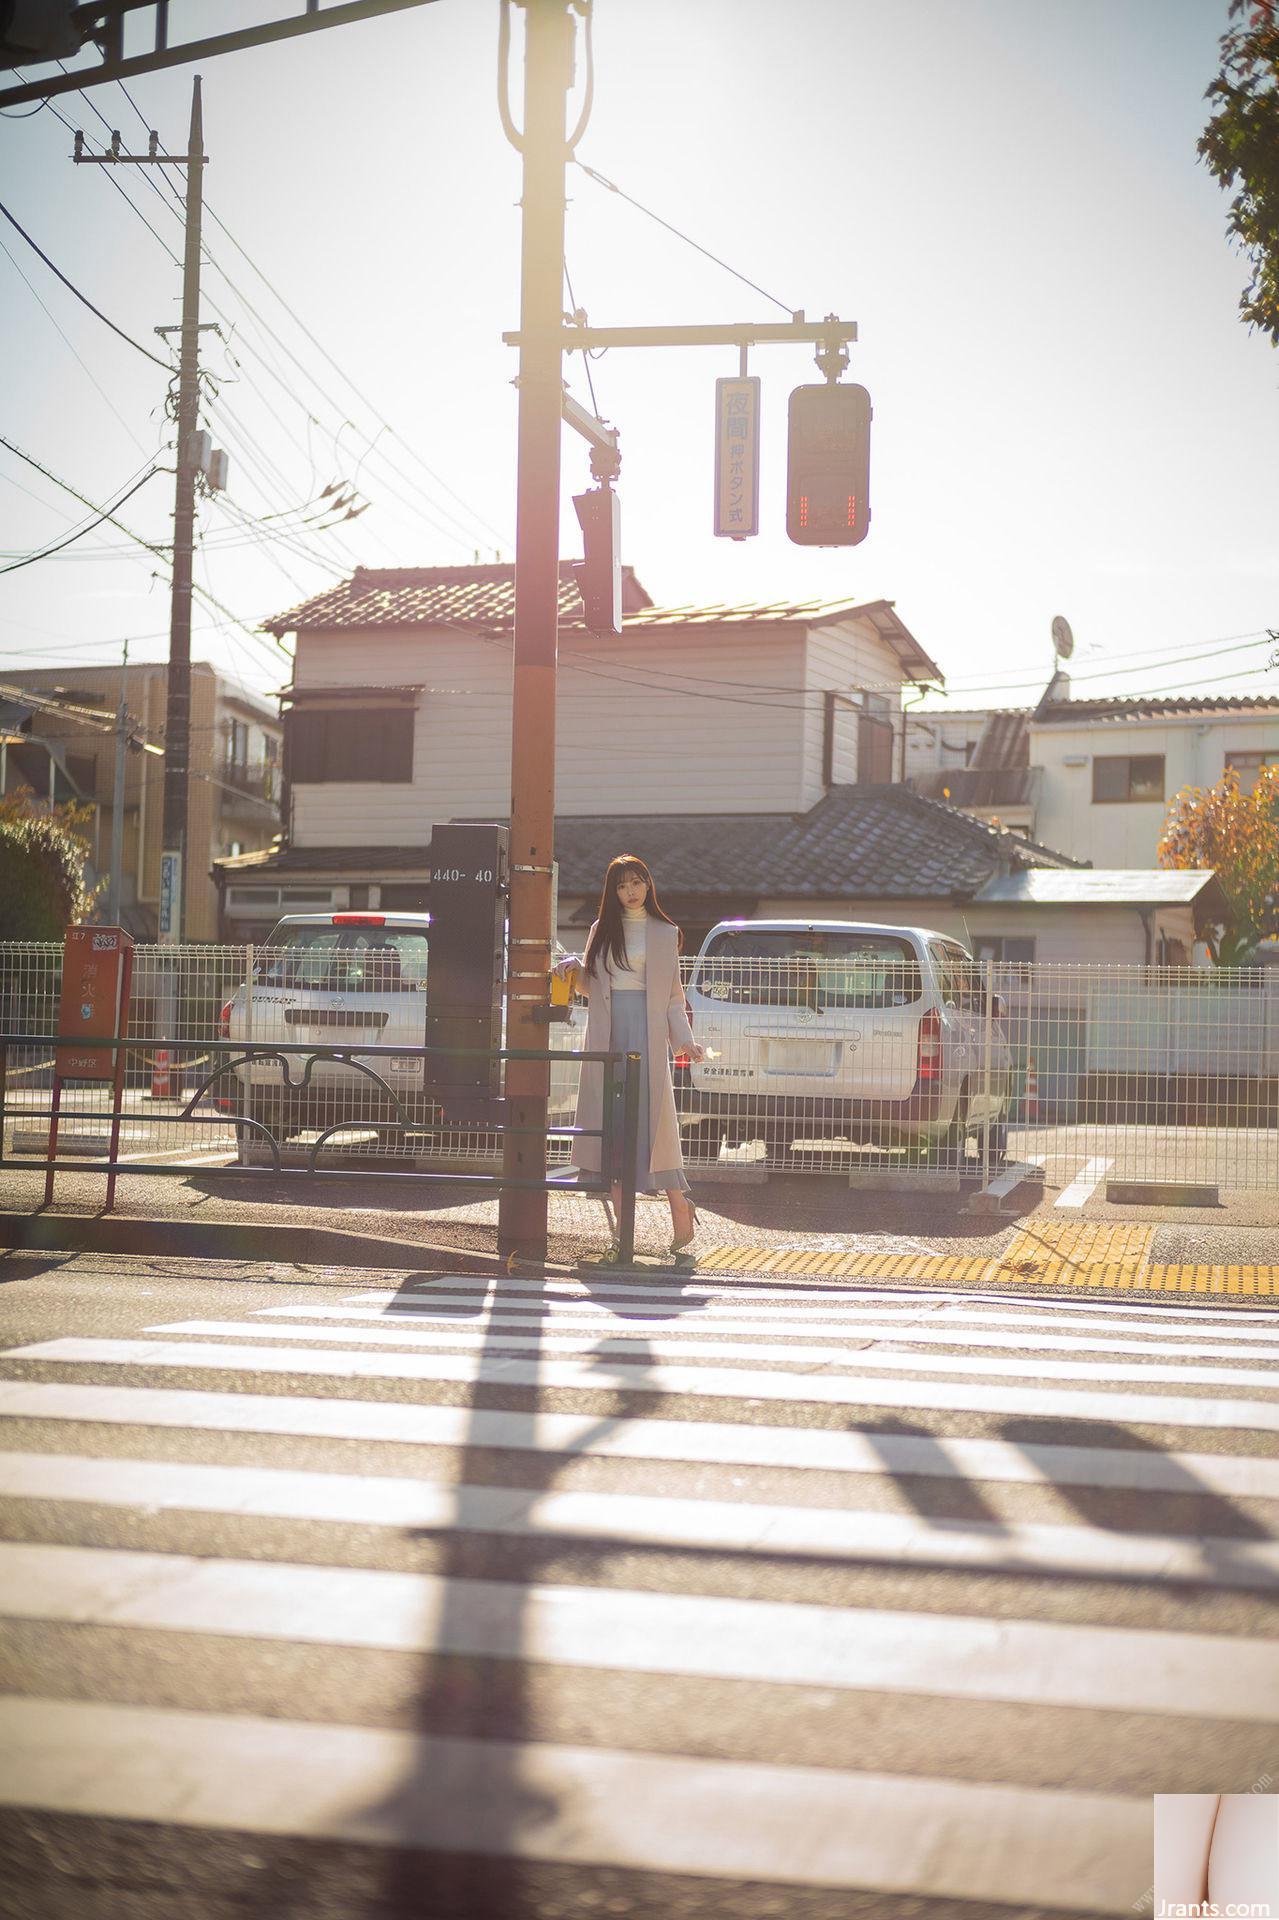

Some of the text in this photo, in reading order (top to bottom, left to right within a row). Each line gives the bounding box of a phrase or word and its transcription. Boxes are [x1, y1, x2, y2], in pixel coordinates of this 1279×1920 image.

[726, 392, 750, 522] 夜間押ボタン式
[433, 868, 492, 882] 440- 40
[81, 962, 98, 1020] 消火
